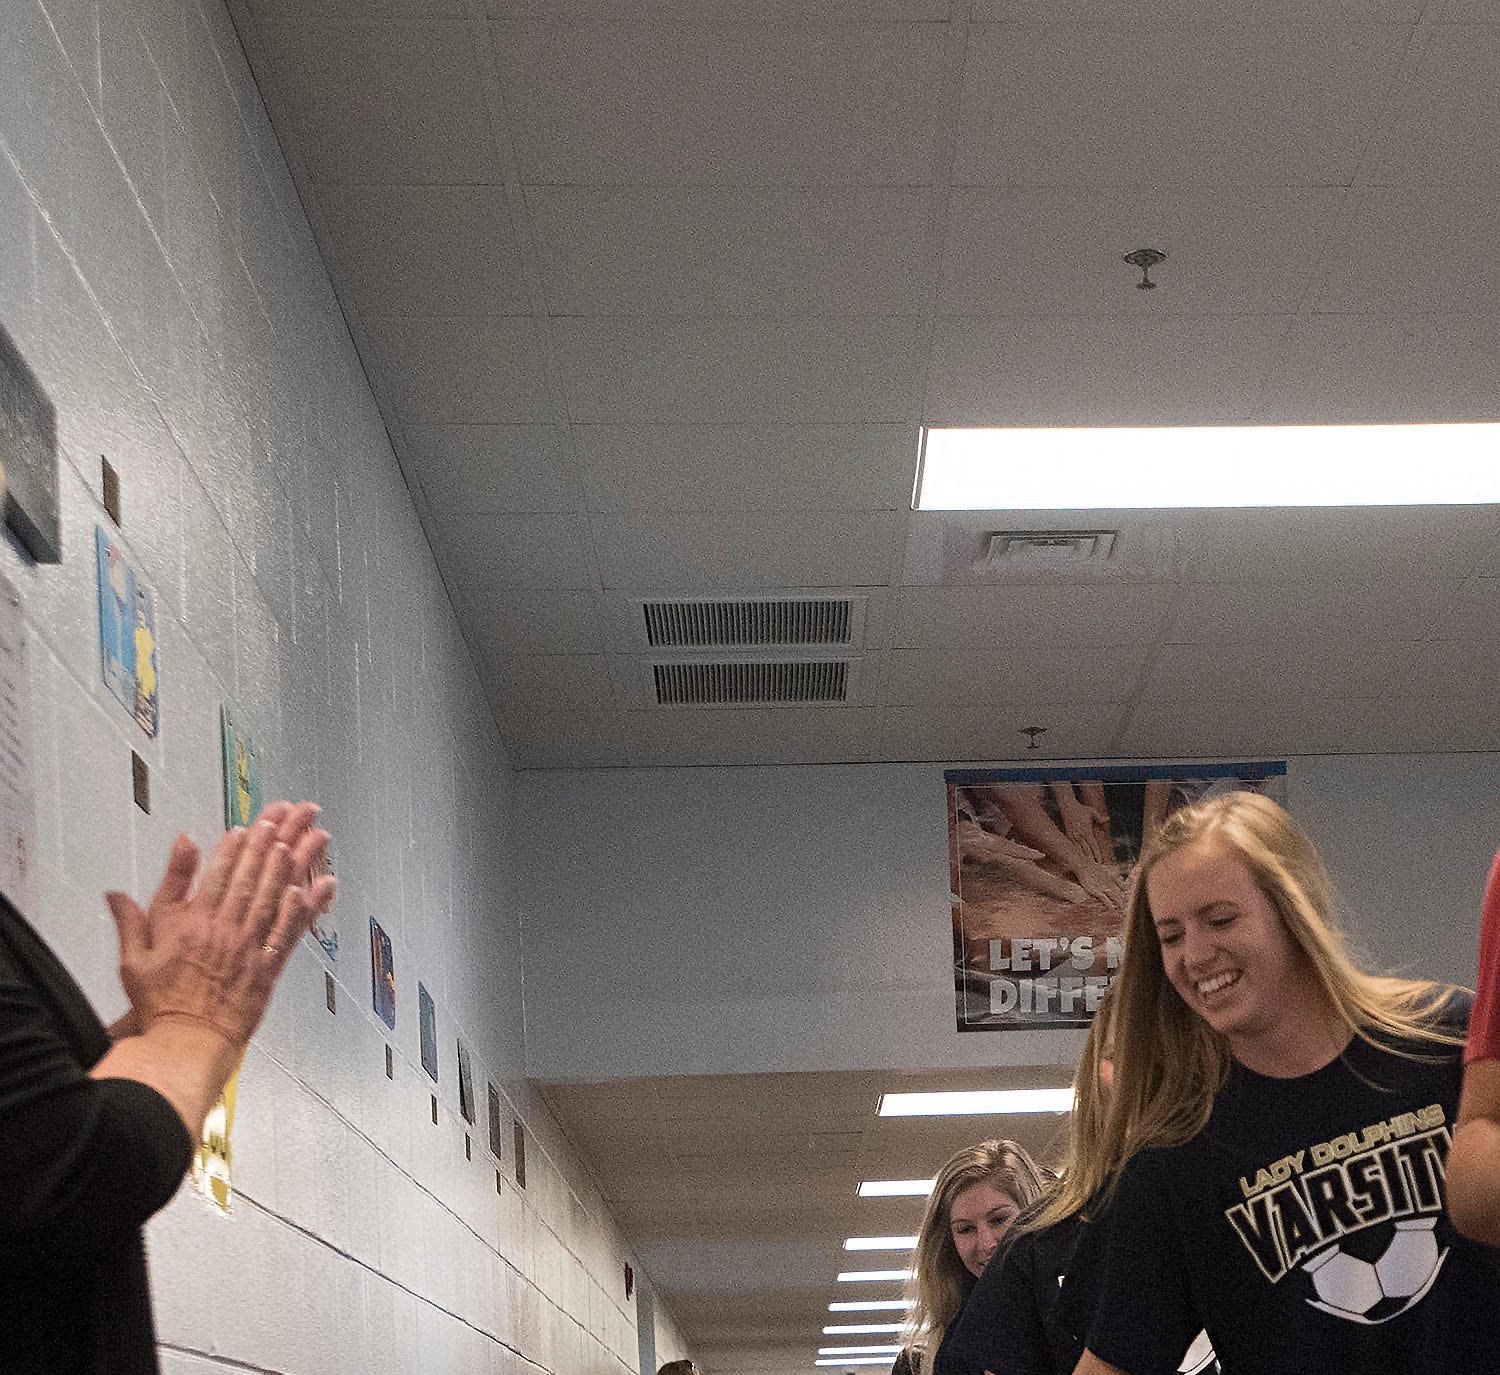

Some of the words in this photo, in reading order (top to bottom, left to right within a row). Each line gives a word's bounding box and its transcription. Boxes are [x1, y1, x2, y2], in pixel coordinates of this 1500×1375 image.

[989, 935, 1096, 971] LET'S
[1239, 1149, 1306, 1199] LADY
[1310, 1103, 1447, 1167] DOLPHINS
